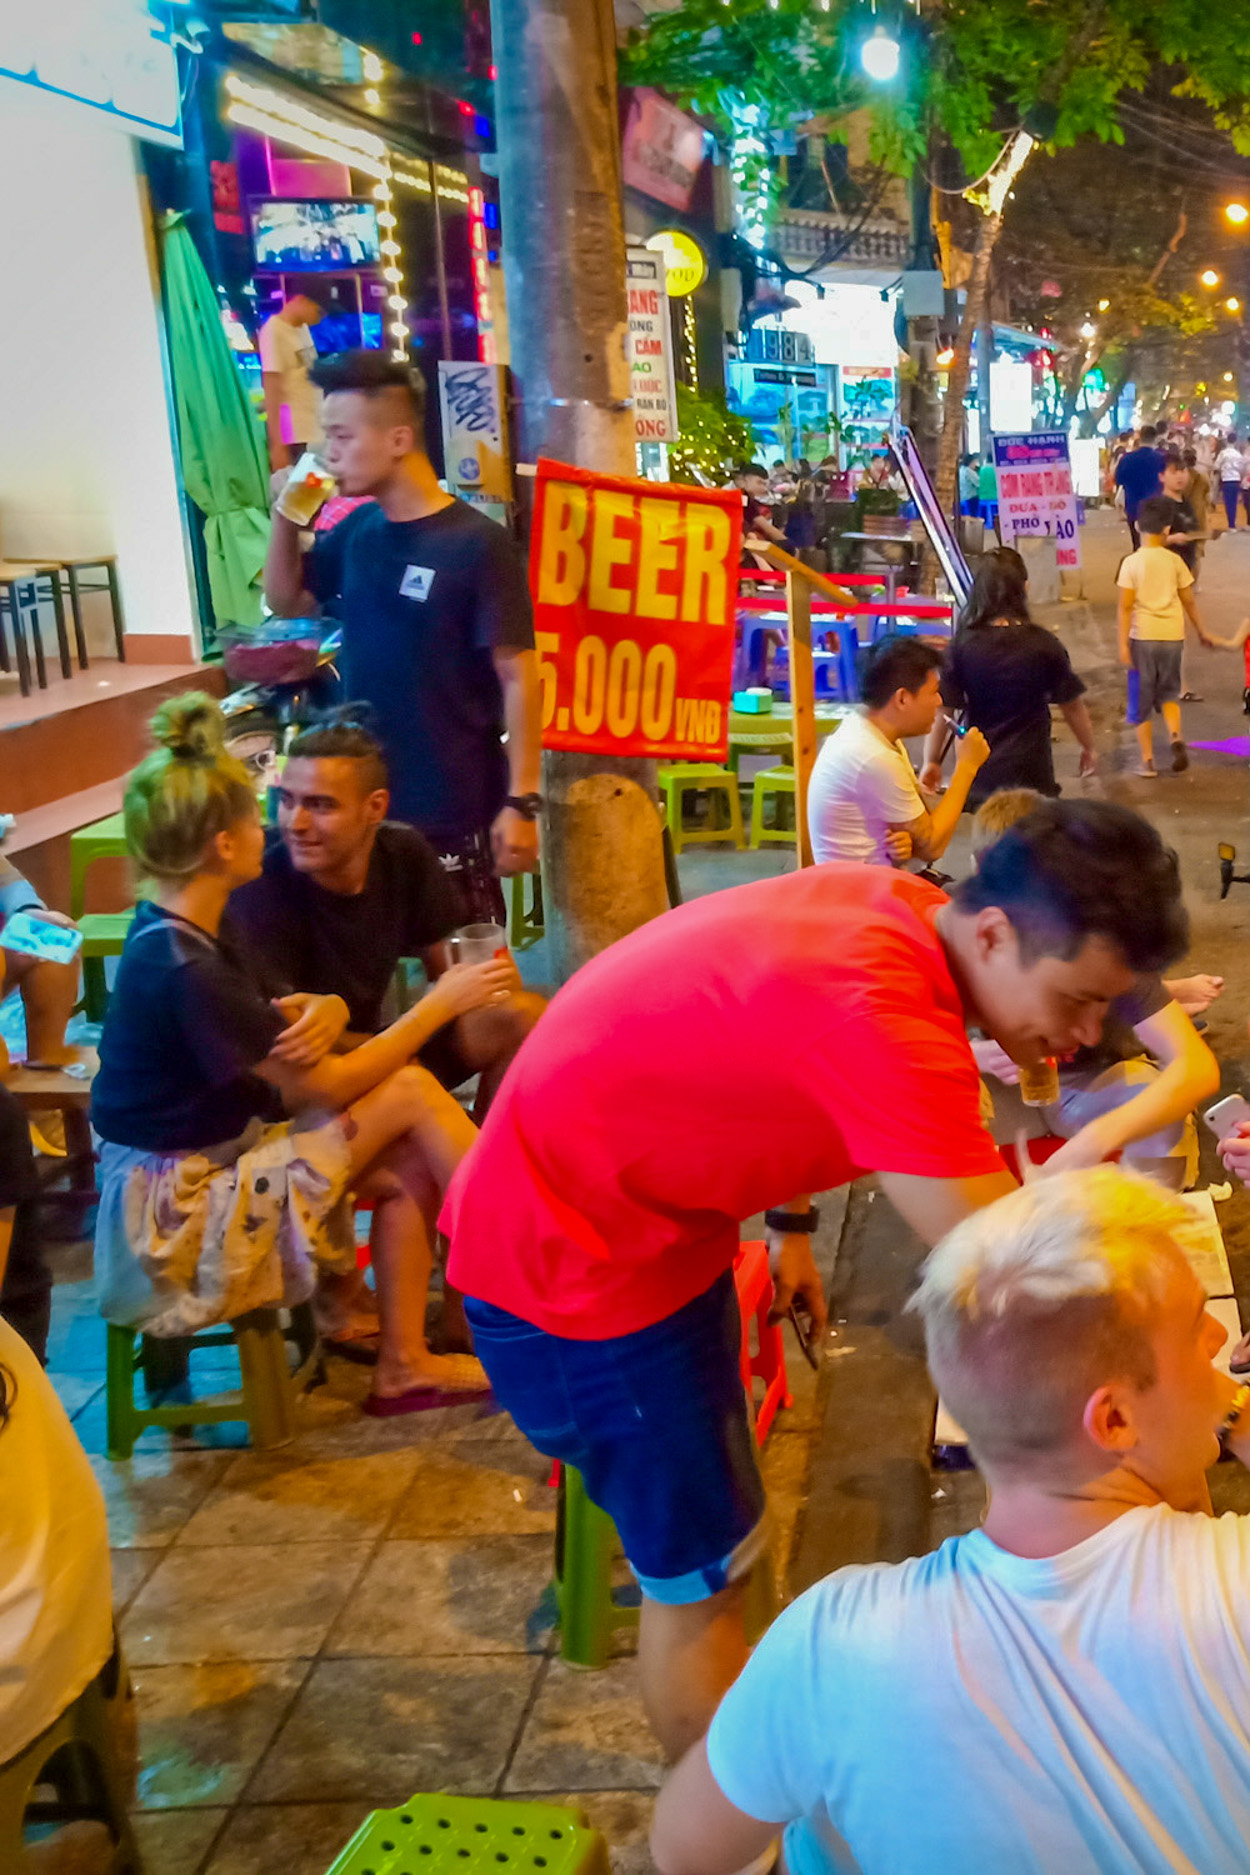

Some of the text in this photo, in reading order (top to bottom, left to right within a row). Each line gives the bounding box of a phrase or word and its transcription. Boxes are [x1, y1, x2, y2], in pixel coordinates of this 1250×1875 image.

[629, 289, 659, 314] ANG
[629, 320, 653, 332] ONG
[538, 480, 731, 626] BEER
[534, 630, 677, 741] 5.000
